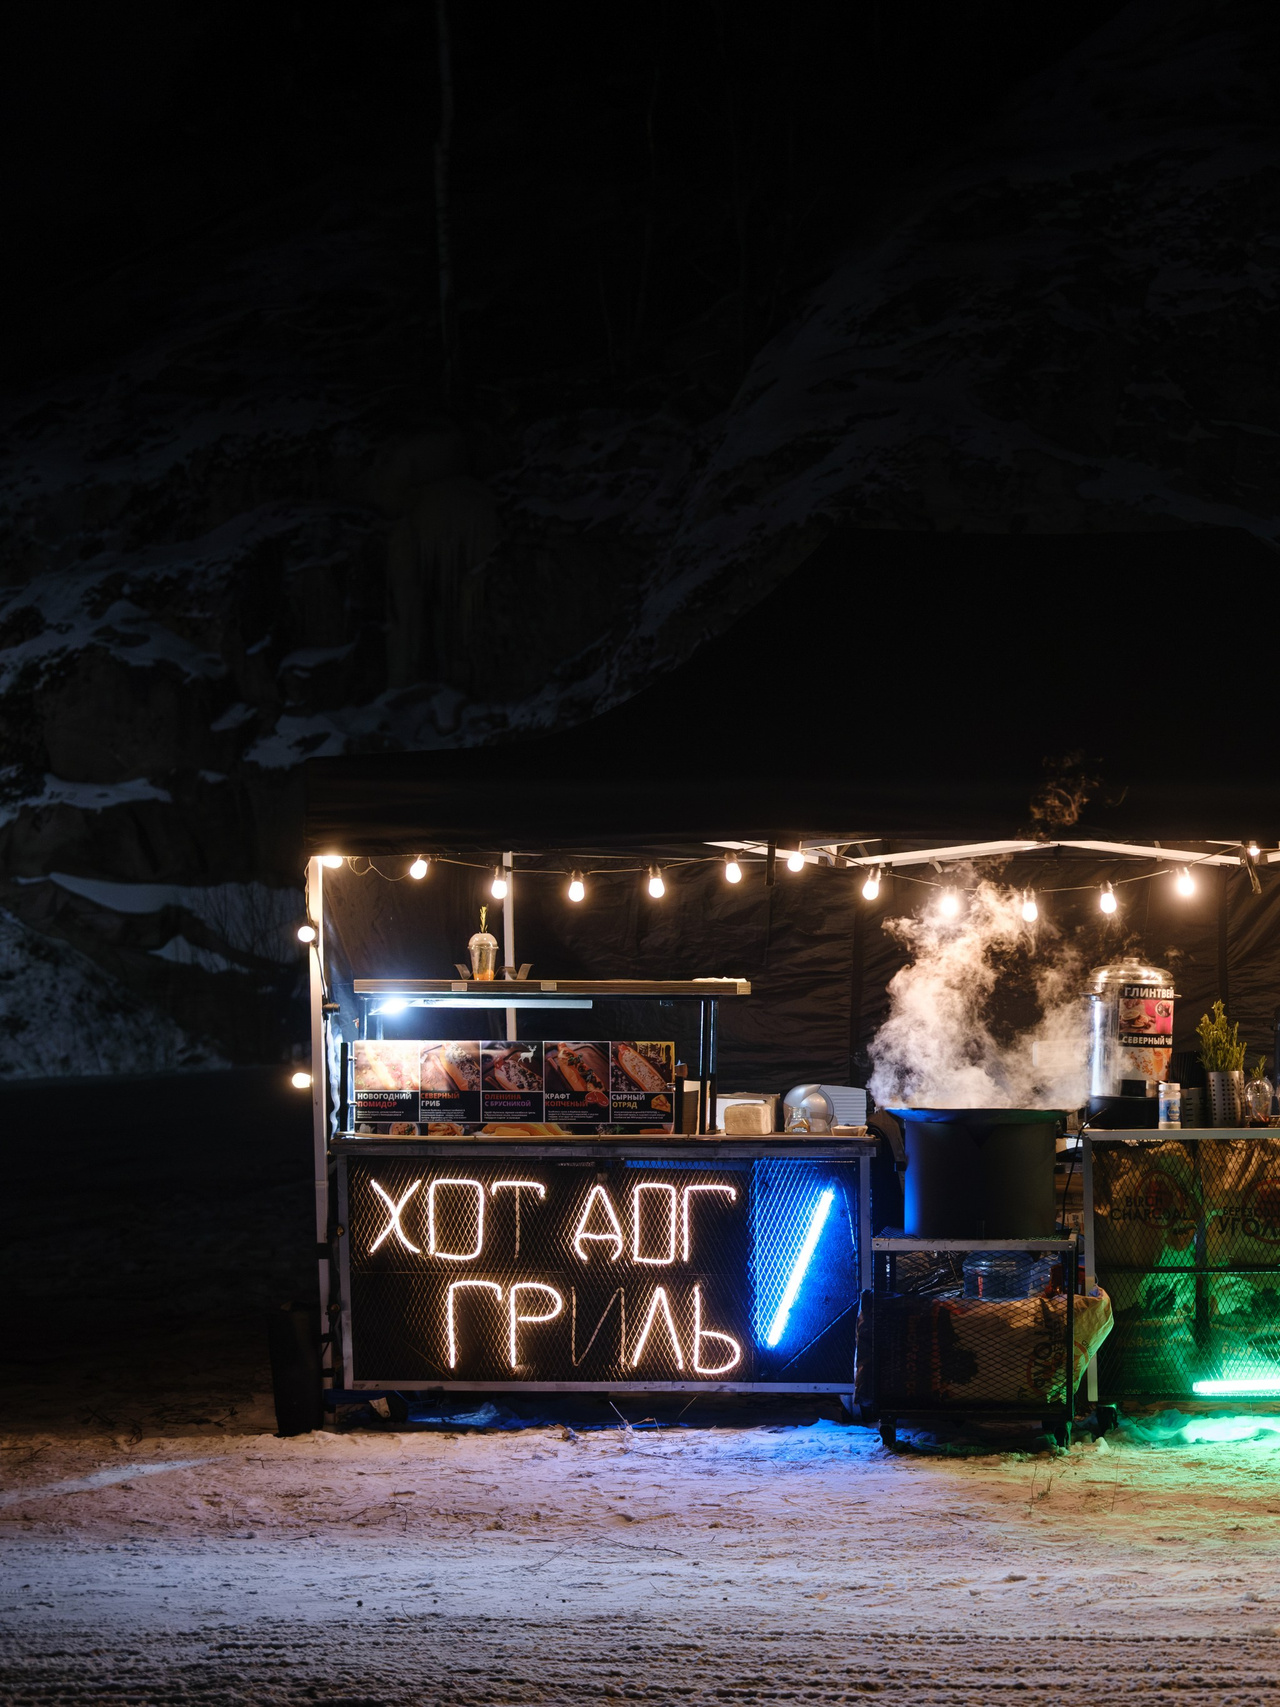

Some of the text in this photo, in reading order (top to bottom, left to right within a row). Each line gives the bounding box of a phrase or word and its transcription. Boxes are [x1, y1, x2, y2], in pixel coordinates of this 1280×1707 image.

[1122, 1035, 1165, 1045] СЕВЕРНЫЙ
[357, 1091, 412, 1100] НОВОГОДНИЙ
[420, 1091, 460, 1100] СЕВЕРНЫЙ
[484, 1093, 522, 1101] ОЛЕНИНА
[611, 1093, 645, 1101] СЫРНЫЙ
[357, 1101, 398, 1109] ПОМИДОР
[490, 1099, 532, 1107] БРУСНИКОЙ
[612, 1101, 638, 1109] ОТРЯД
[1125, 1195, 1163, 1207] BIRCH
[1110, 1207, 1189, 1221] CHARCOAL
[369, 1178, 738, 1265] ХОТ ДОГ
[447, 1280, 742, 1375] ГРИЛЬ
